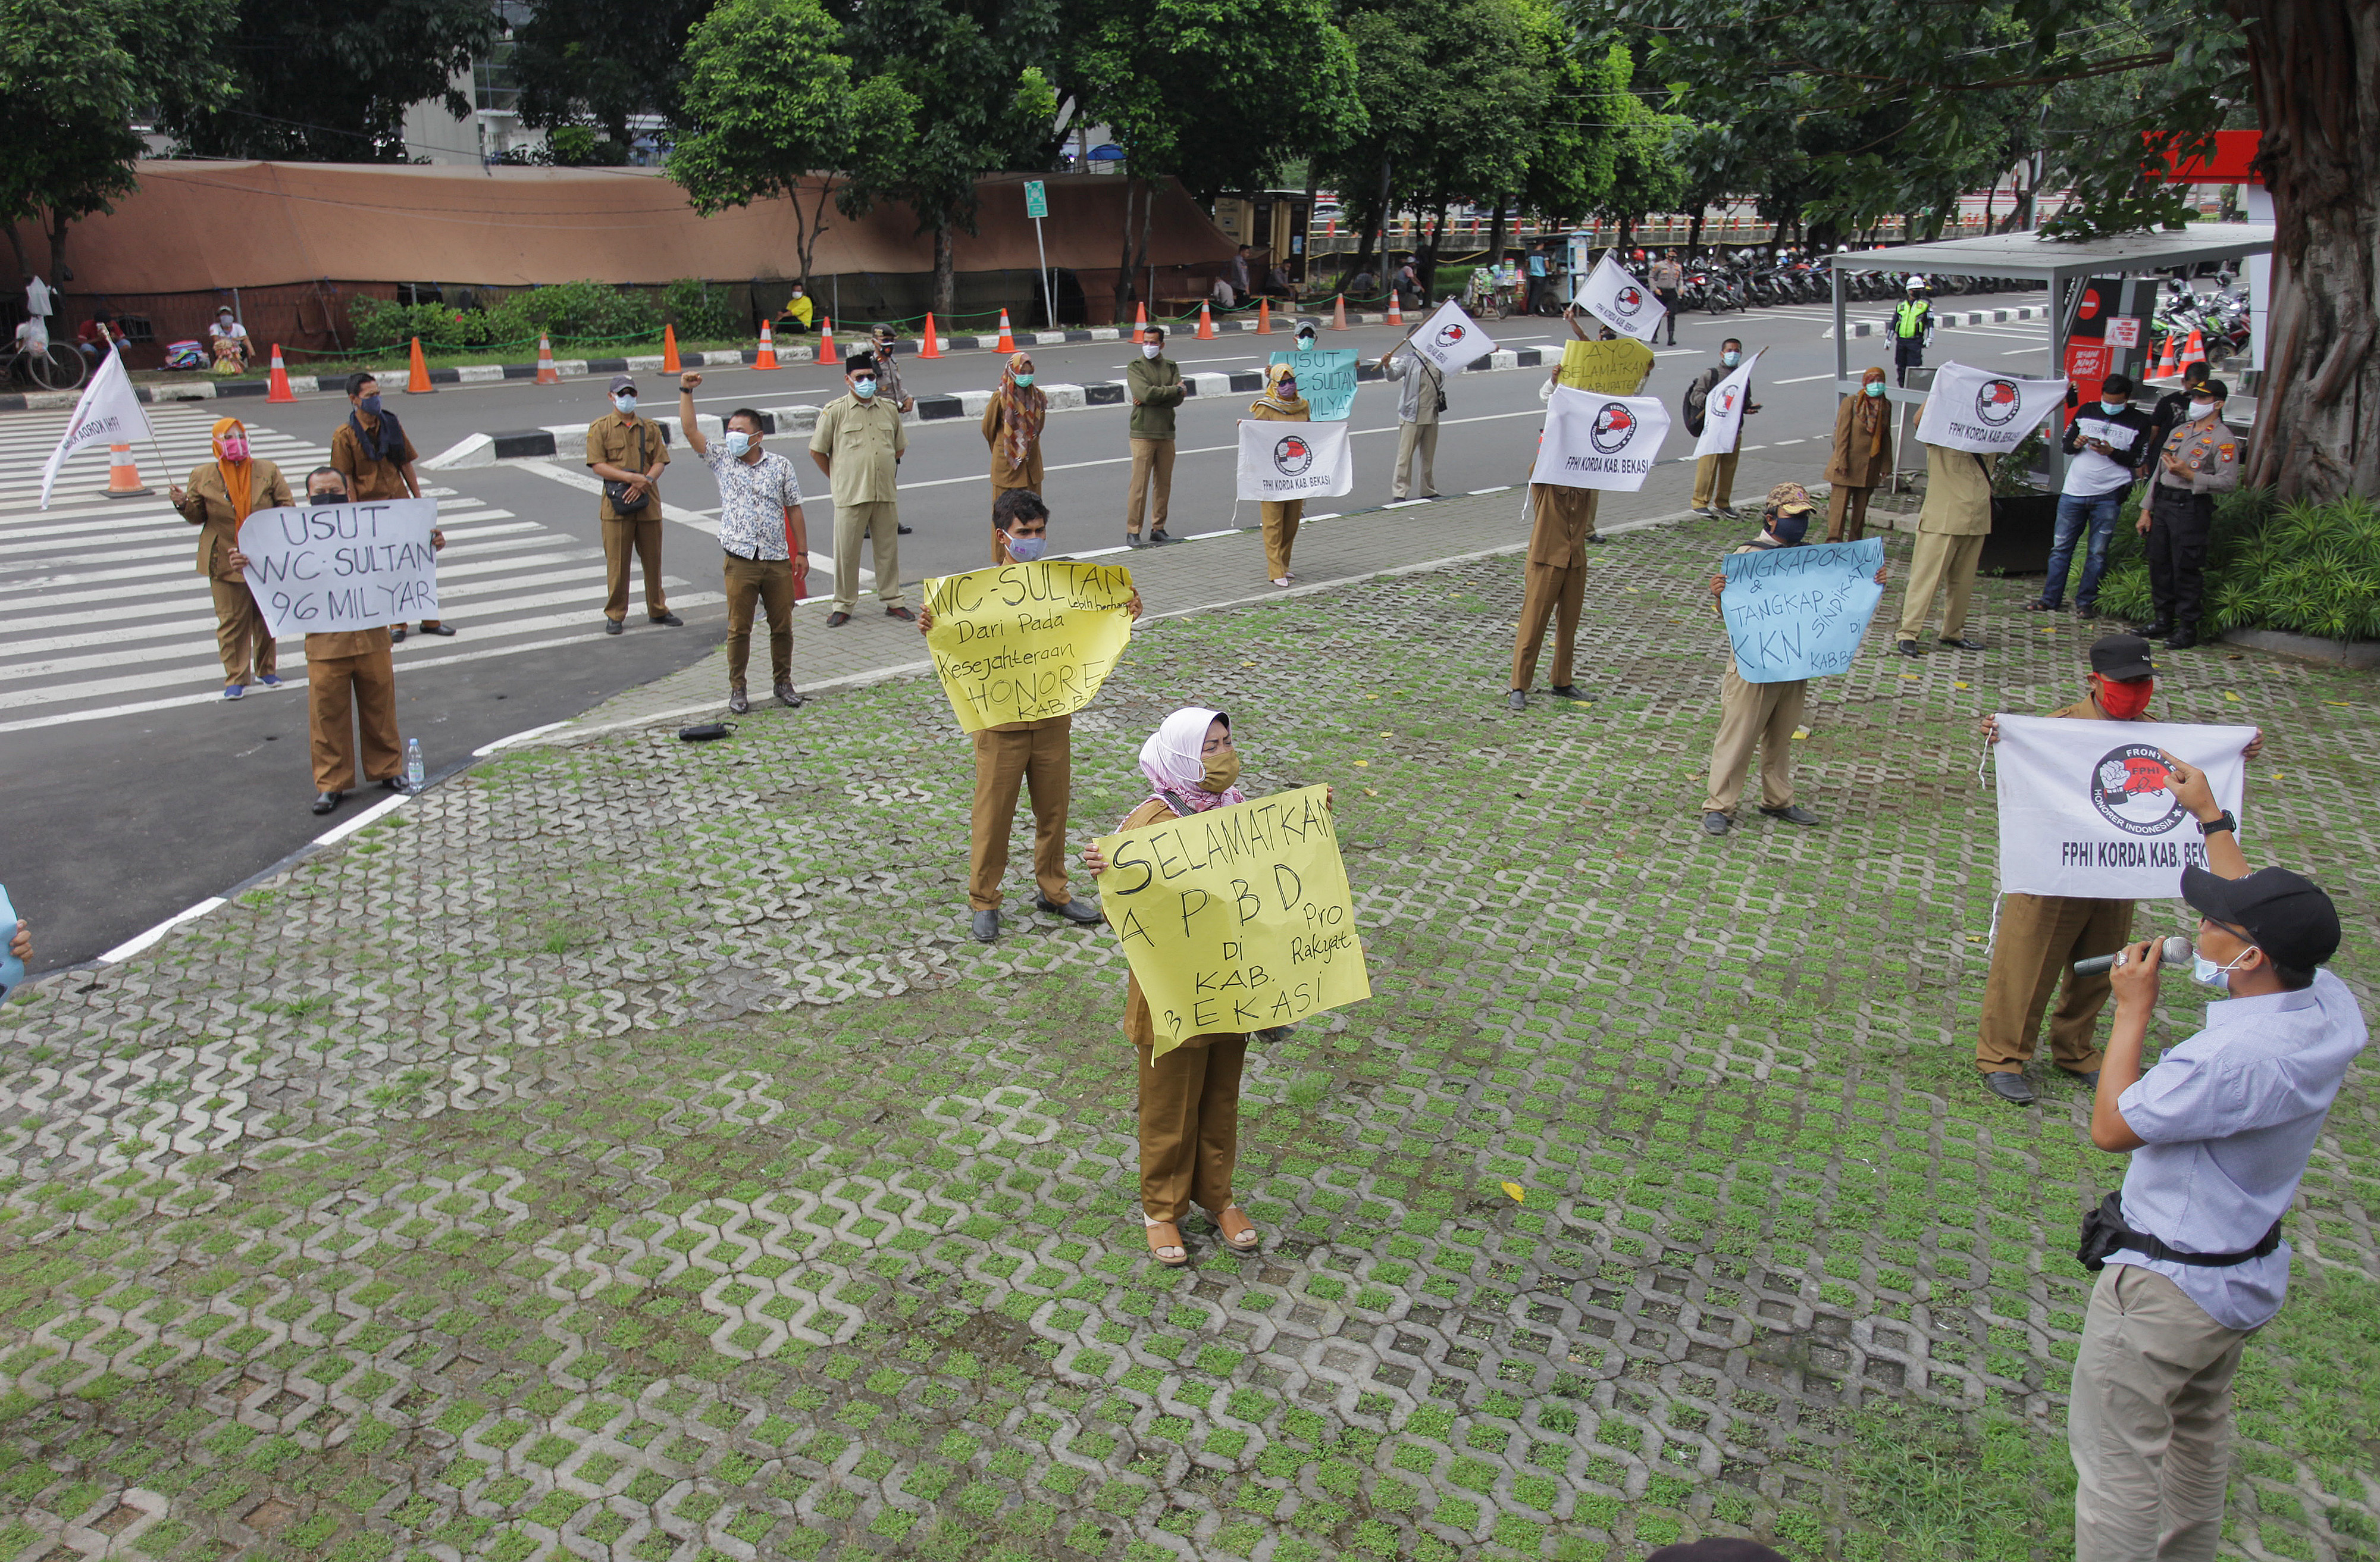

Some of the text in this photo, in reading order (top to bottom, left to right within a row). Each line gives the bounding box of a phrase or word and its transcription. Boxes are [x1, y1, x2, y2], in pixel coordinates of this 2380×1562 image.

[1286, 352, 1340, 369] USUT
[1584, 343, 1634, 364] AYO
[1561, 361, 1649, 379] SELAMATKAN
[1948, 422, 1965, 437] FPHI
[1964, 425, 1988, 442] KORDA
[1565, 456, 1648, 474] FPHI KORDA KAB. BEKASI
[1263, 475, 1331, 491] FPHI KORDA KAB. BEKASI
[280, 506, 390, 546] USUT
[1750, 580, 1763, 594] &
[272, 591, 319, 627] 96
[1730, 590, 1824, 628] TANGKAP
[954, 608, 1064, 644] Dari Pada
[1731, 622, 1803, 669] KKN
[937, 642, 1075, 685] Kesejahteraan
[2126, 749, 2162, 760] FRONT
[2132, 767, 2160, 775] FPHI
[2094, 789, 2175, 834] HONORER INDONESIA
[1112, 795, 1332, 895] SELAMATKAN
[2062, 842, 2209, 868] FPHI KORDA KAB. BEK
[1291, 931, 1351, 965] Rakyat
[1196, 966, 1276, 994] KAB.
